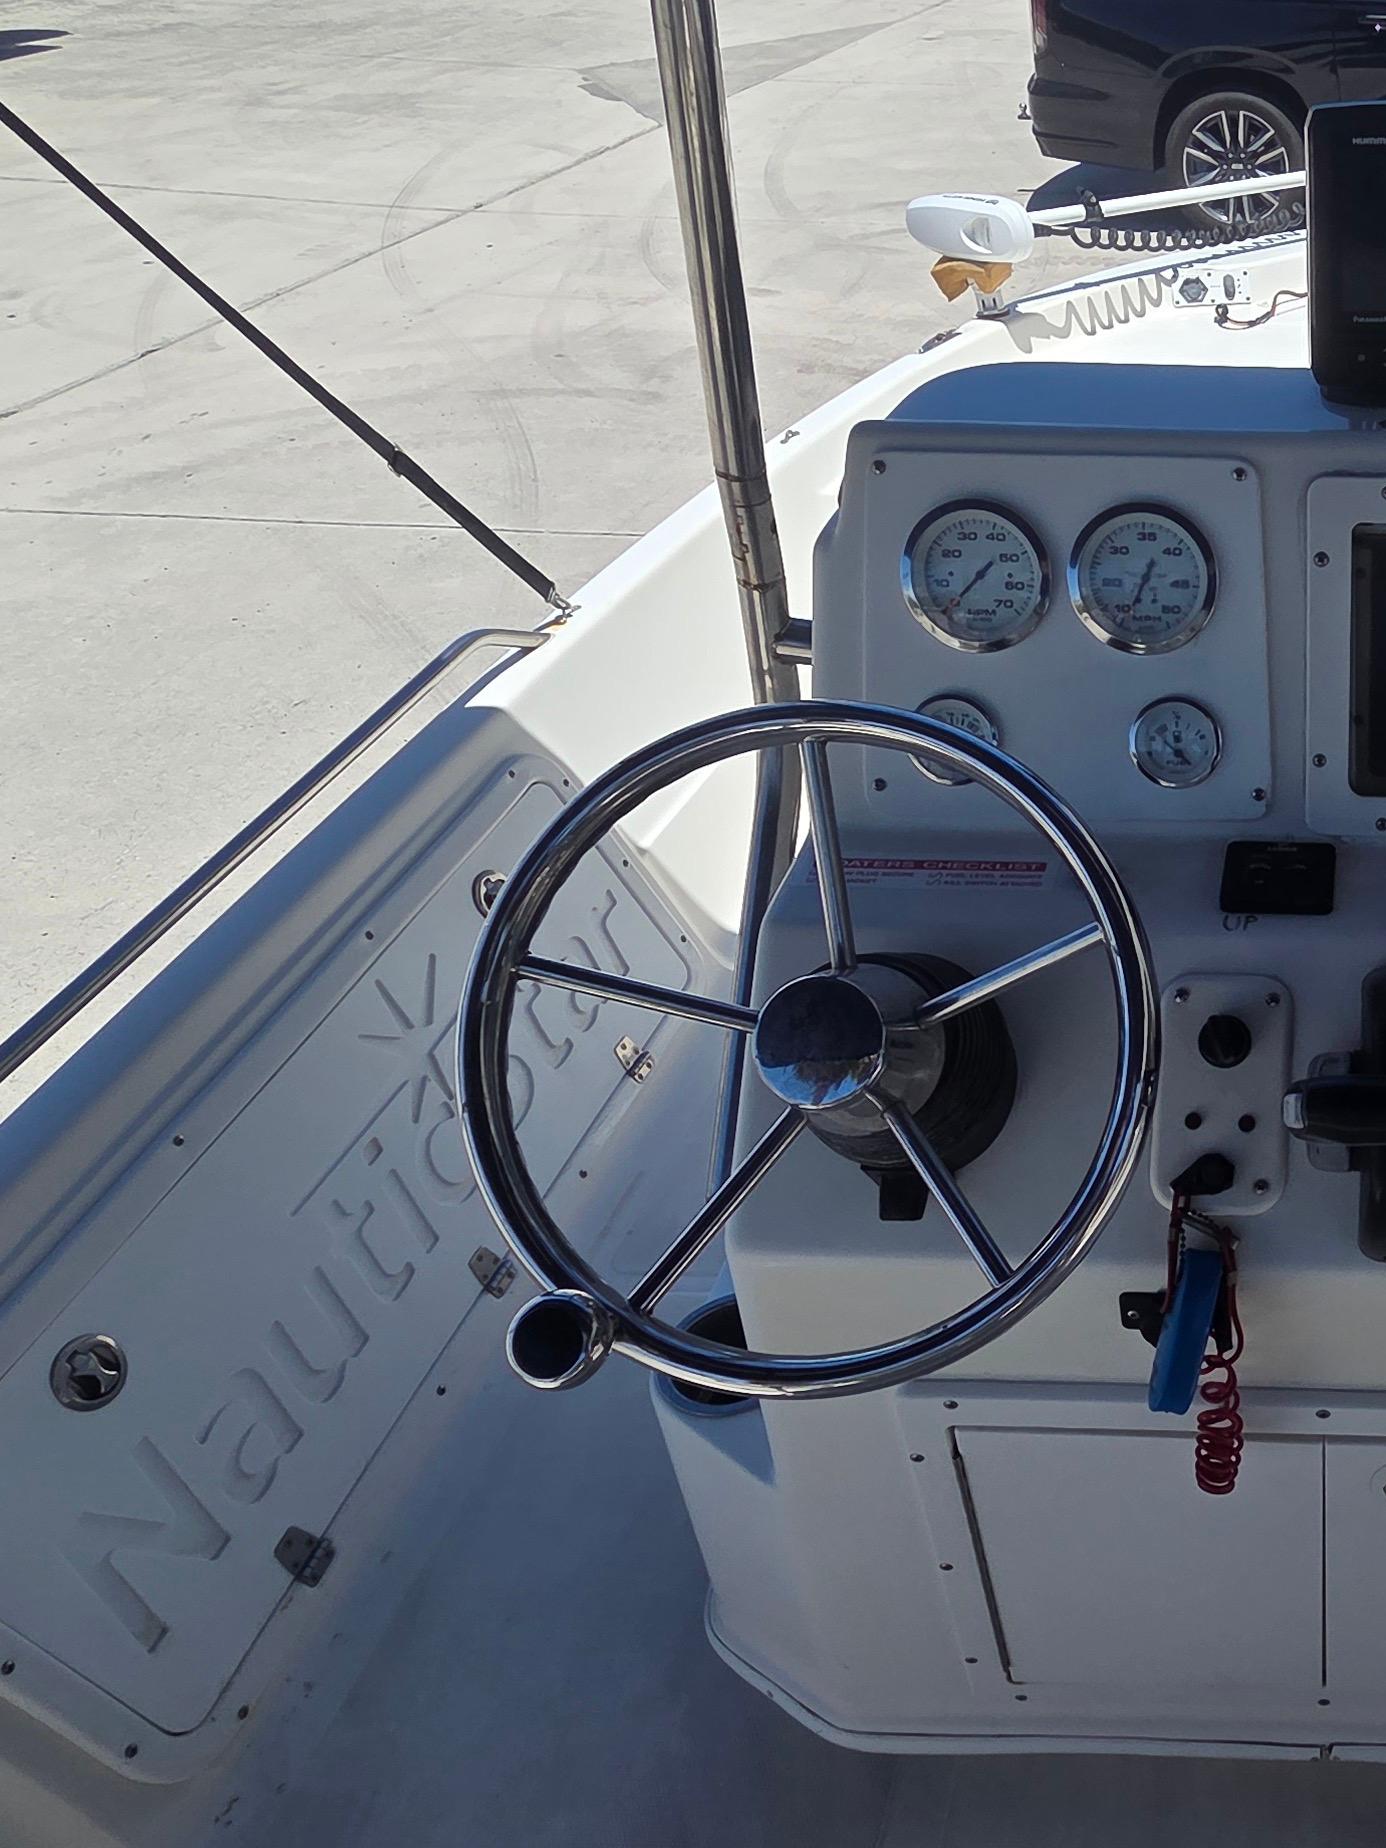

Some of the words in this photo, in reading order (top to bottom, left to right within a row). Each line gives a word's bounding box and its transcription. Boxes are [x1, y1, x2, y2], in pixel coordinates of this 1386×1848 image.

[957, 531, 978, 541] 30
[985, 532, 1006, 542] 40
[1136, 532, 1157, 542] 35
[941, 549, 962, 559] 20
[1109, 546, 1130, 556] 30
[1162, 547, 1183, 557] 40
[993, 599, 1014, 609] 70
[842, 860, 915, 869] ATERS
[923, 861, 1041, 871] CHECKLIST
[1222, 914, 1259, 931] UP
